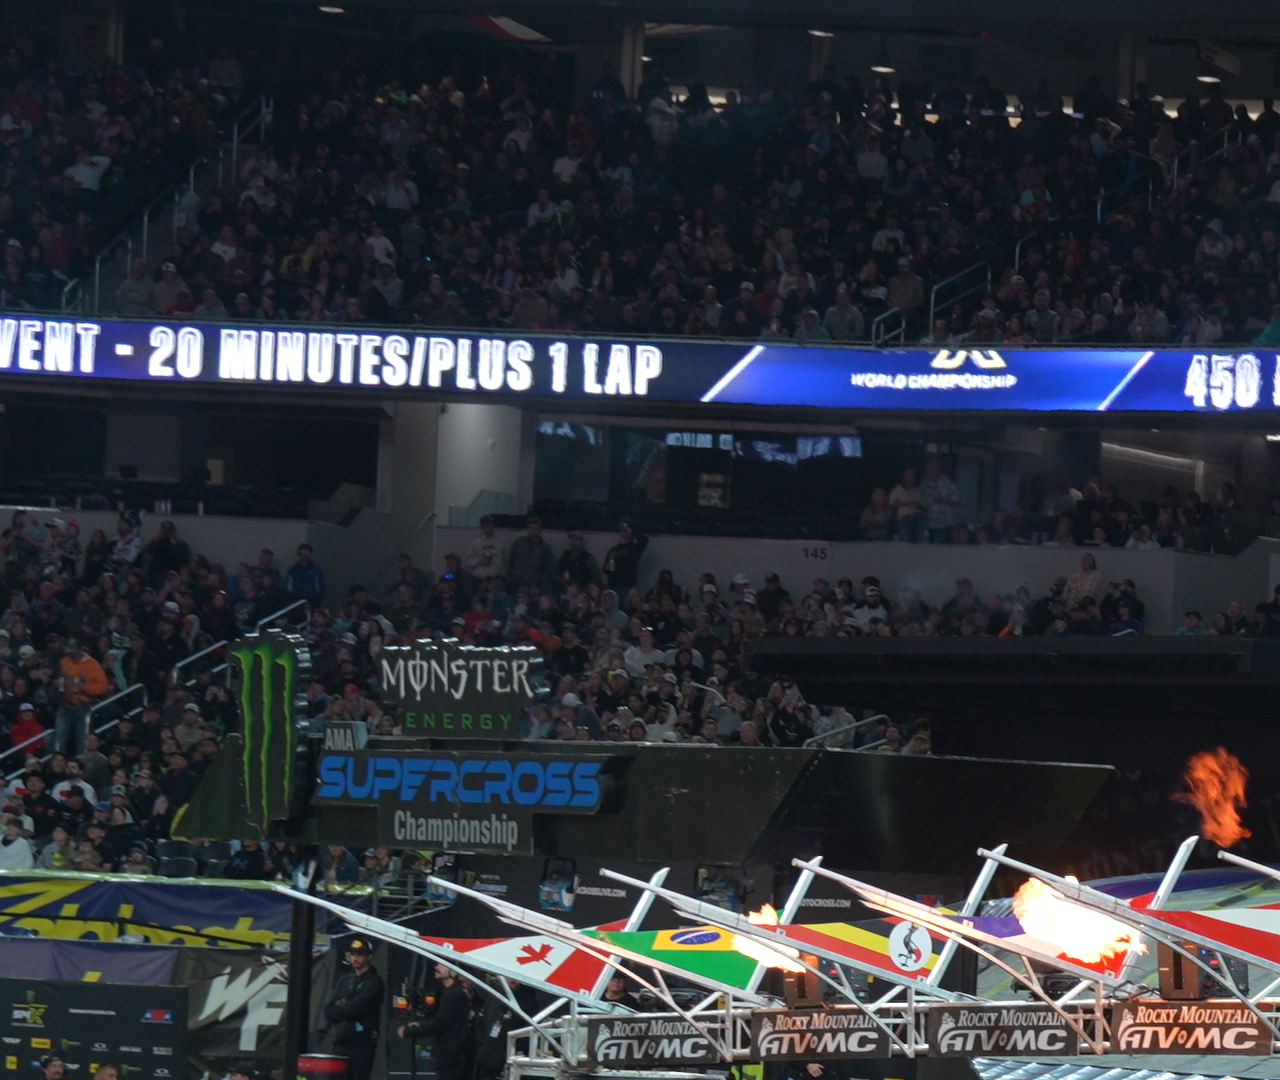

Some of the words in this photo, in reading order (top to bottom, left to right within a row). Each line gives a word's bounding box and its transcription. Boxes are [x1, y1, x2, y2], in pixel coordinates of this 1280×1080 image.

[149, 327, 203, 378] 20
[219, 329, 534, 391] MINUTES/PLUS
[548, 342, 567, 393] 1
[583, 343, 663, 395] LAP
[851, 374, 907, 389] WORLD
[908, 373, 1017, 391] CHAMPIONSHIP
[1184, 354, 1262, 409] 450
[803, 548, 827, 560] 145
[381, 651, 534, 700] MONSTER
[405, 712, 512, 730] ENERGY
[324, 728, 354, 750] AMA
[317, 756, 602, 807] SUPERCROSS
[394, 810, 519, 850] Championship
[775, 1014, 808, 1030] ROCKY
[810, 1012, 880, 1029] MOUNTAIN
[957, 1010, 998, 1027] ROCKY
[1000, 1009, 1067, 1027] MOUNTAIN
[1135, 1006, 1178, 1025] ROCKY
[1179, 1006, 1259, 1025] MOUNTAIN
[613, 1021, 648, 1036] ROCKY
